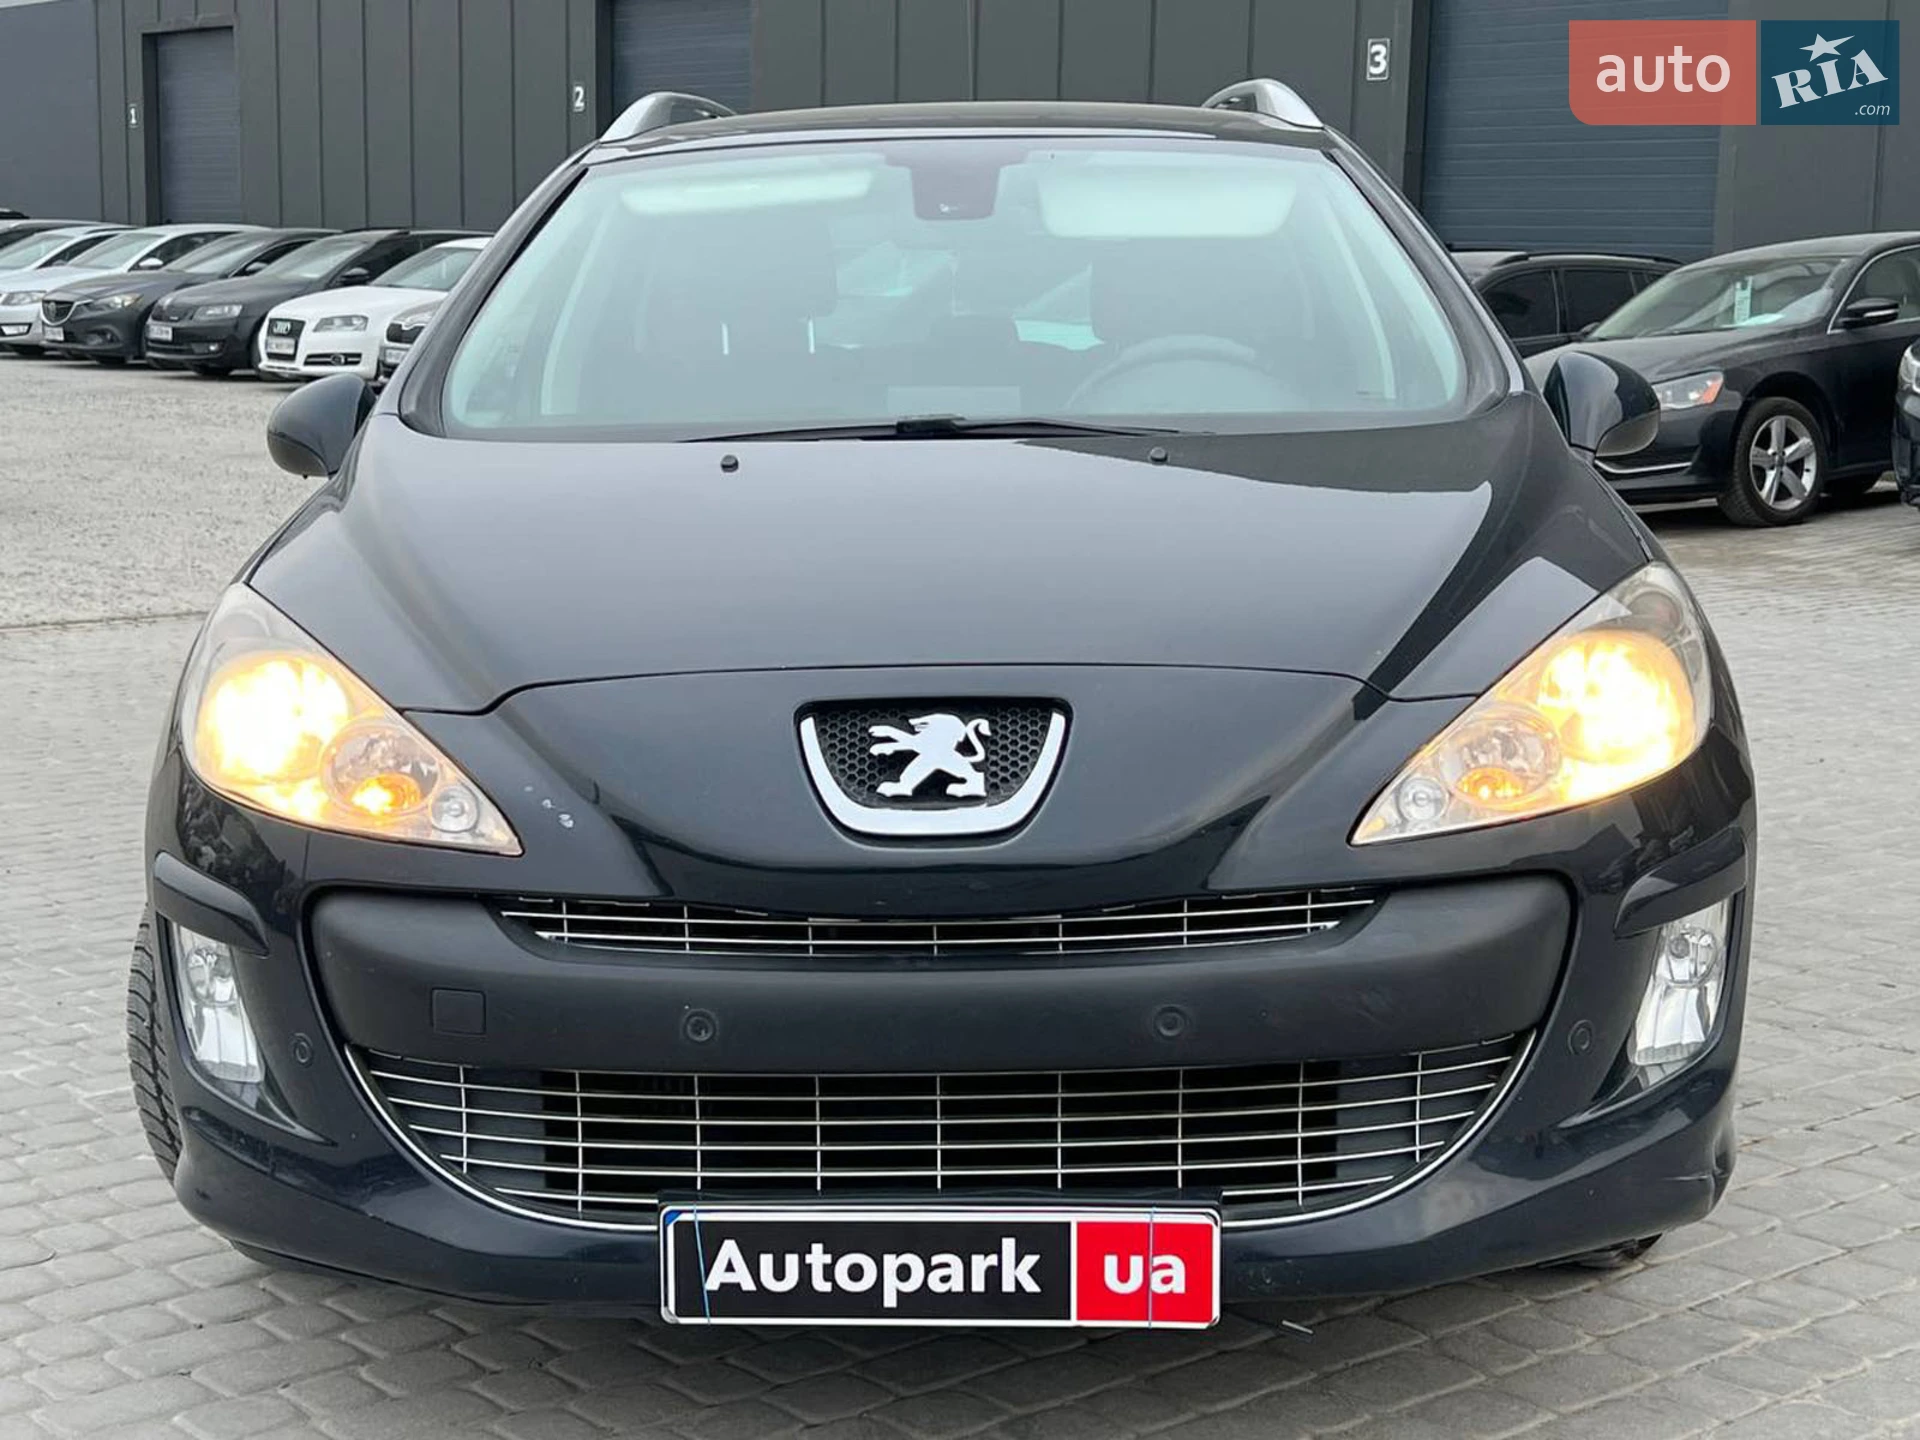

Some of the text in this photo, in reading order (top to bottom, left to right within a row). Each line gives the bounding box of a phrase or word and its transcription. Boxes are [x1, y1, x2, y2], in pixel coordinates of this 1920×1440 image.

[1369, 43, 1388, 75] 3
[574, 86, 585, 108] 2
[130, 107, 137, 125] 1
[703, 1238, 1186, 1308] Autopark ua
